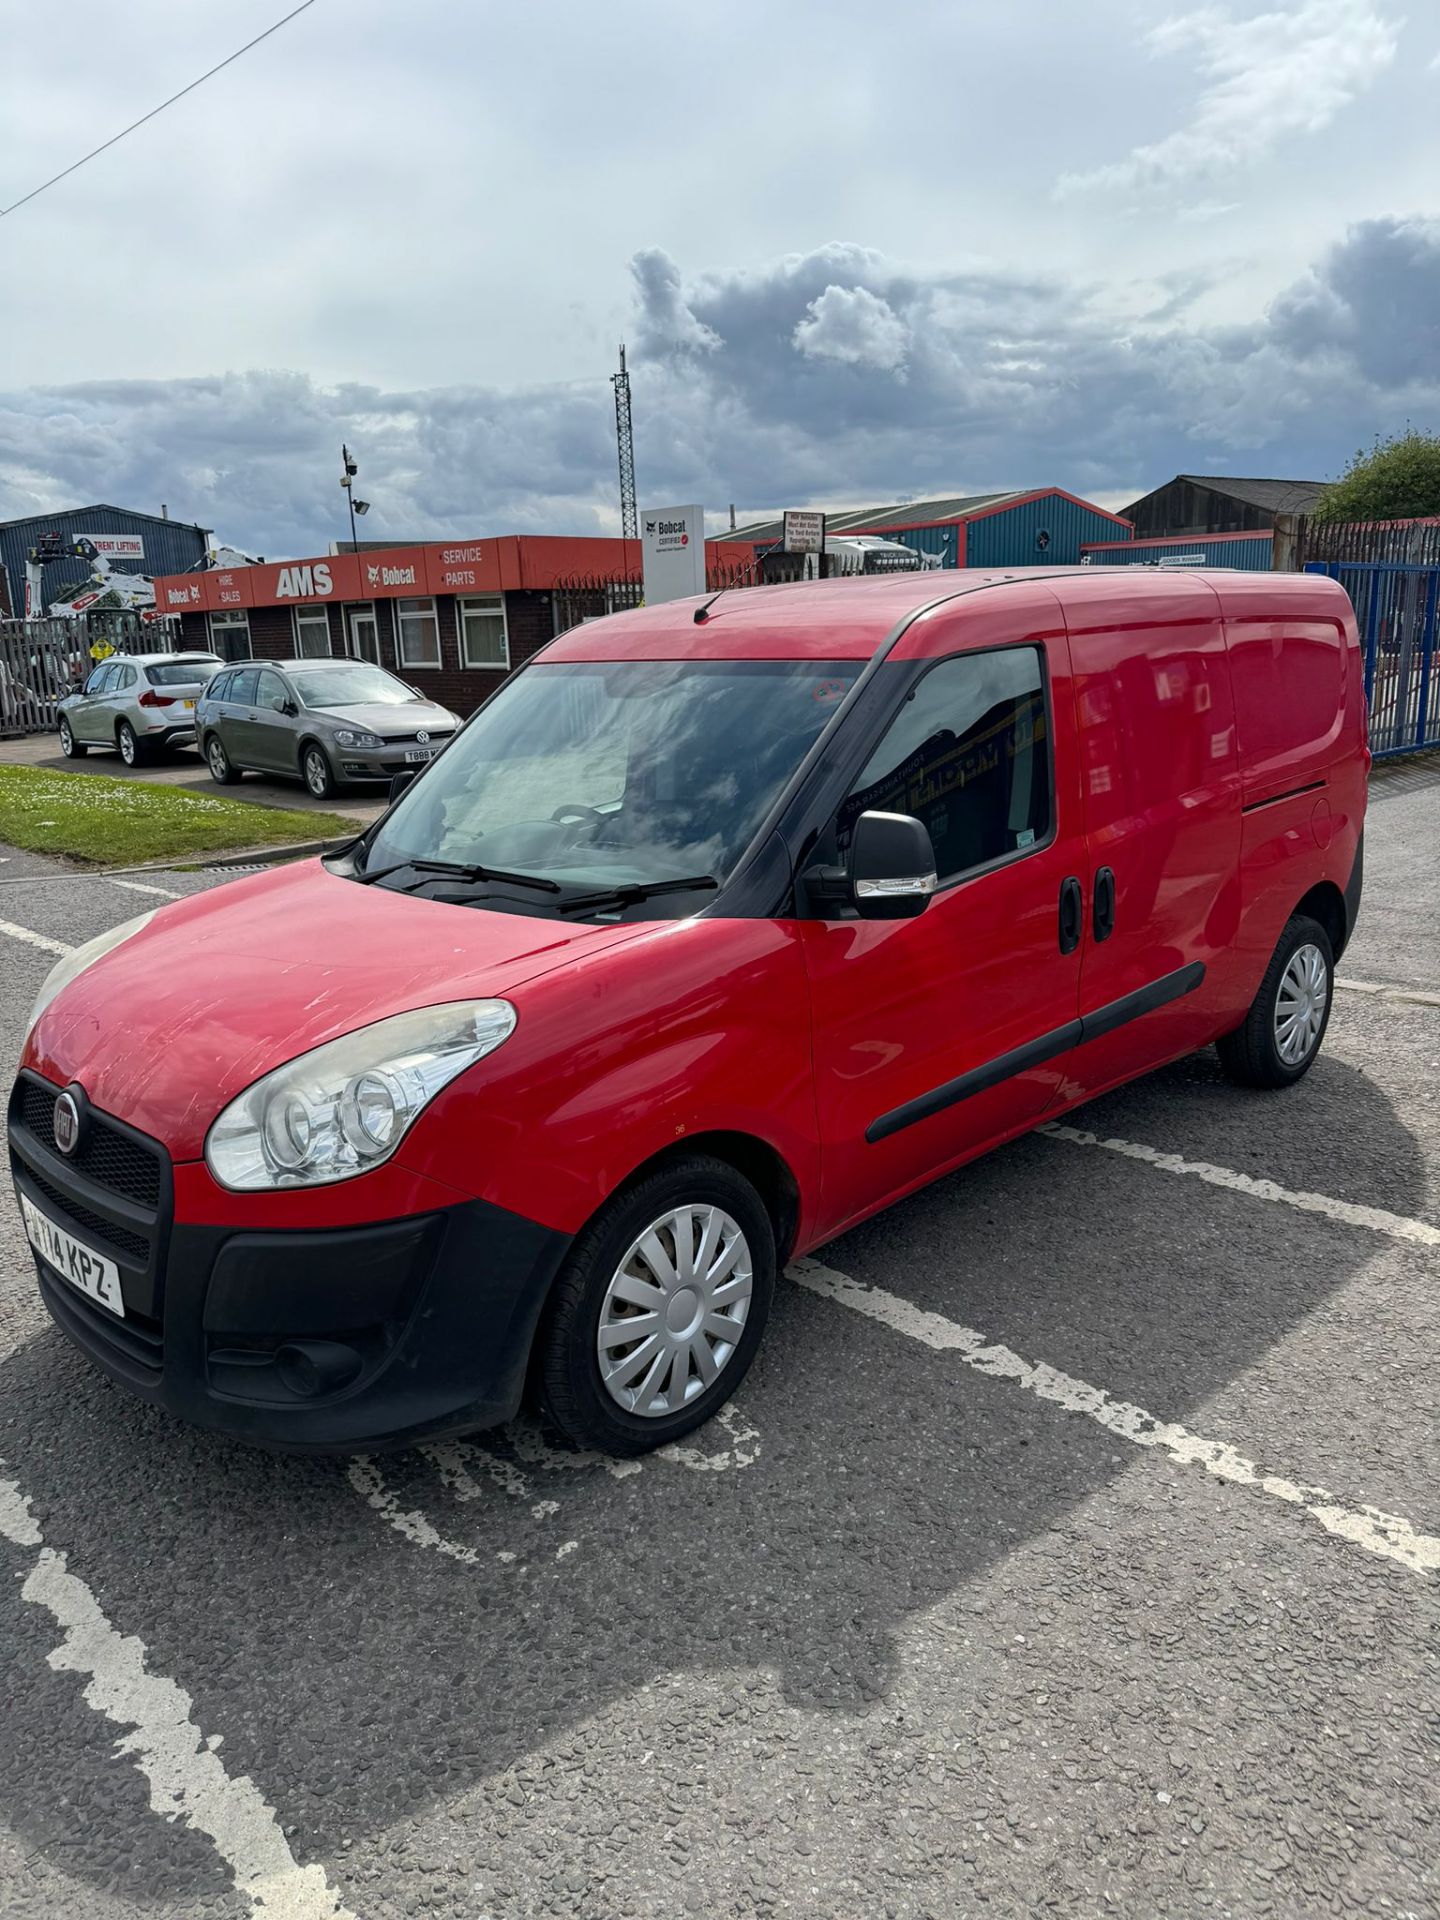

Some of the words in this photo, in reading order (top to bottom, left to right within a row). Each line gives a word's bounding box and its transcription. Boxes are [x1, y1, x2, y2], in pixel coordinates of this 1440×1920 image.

[659, 520, 686, 535] Bobcat
[94, 541, 115, 551] TRENT
[116, 541, 141, 551] LIFTING
[659, 536, 681, 546] CERTIFIED
[443, 547, 482, 564] SERVICE
[219, 575, 233, 586] HIRE
[275, 563, 334, 598] AMS
[382, 565, 416, 586] Bobcat
[445, 570, 475, 586] PARTS
[221, 590, 241, 603] SALES
[408, 751, 429, 761] T888
[57, 1108, 72, 1139] FIAT
[66, 1240, 110, 1301] KPZ
